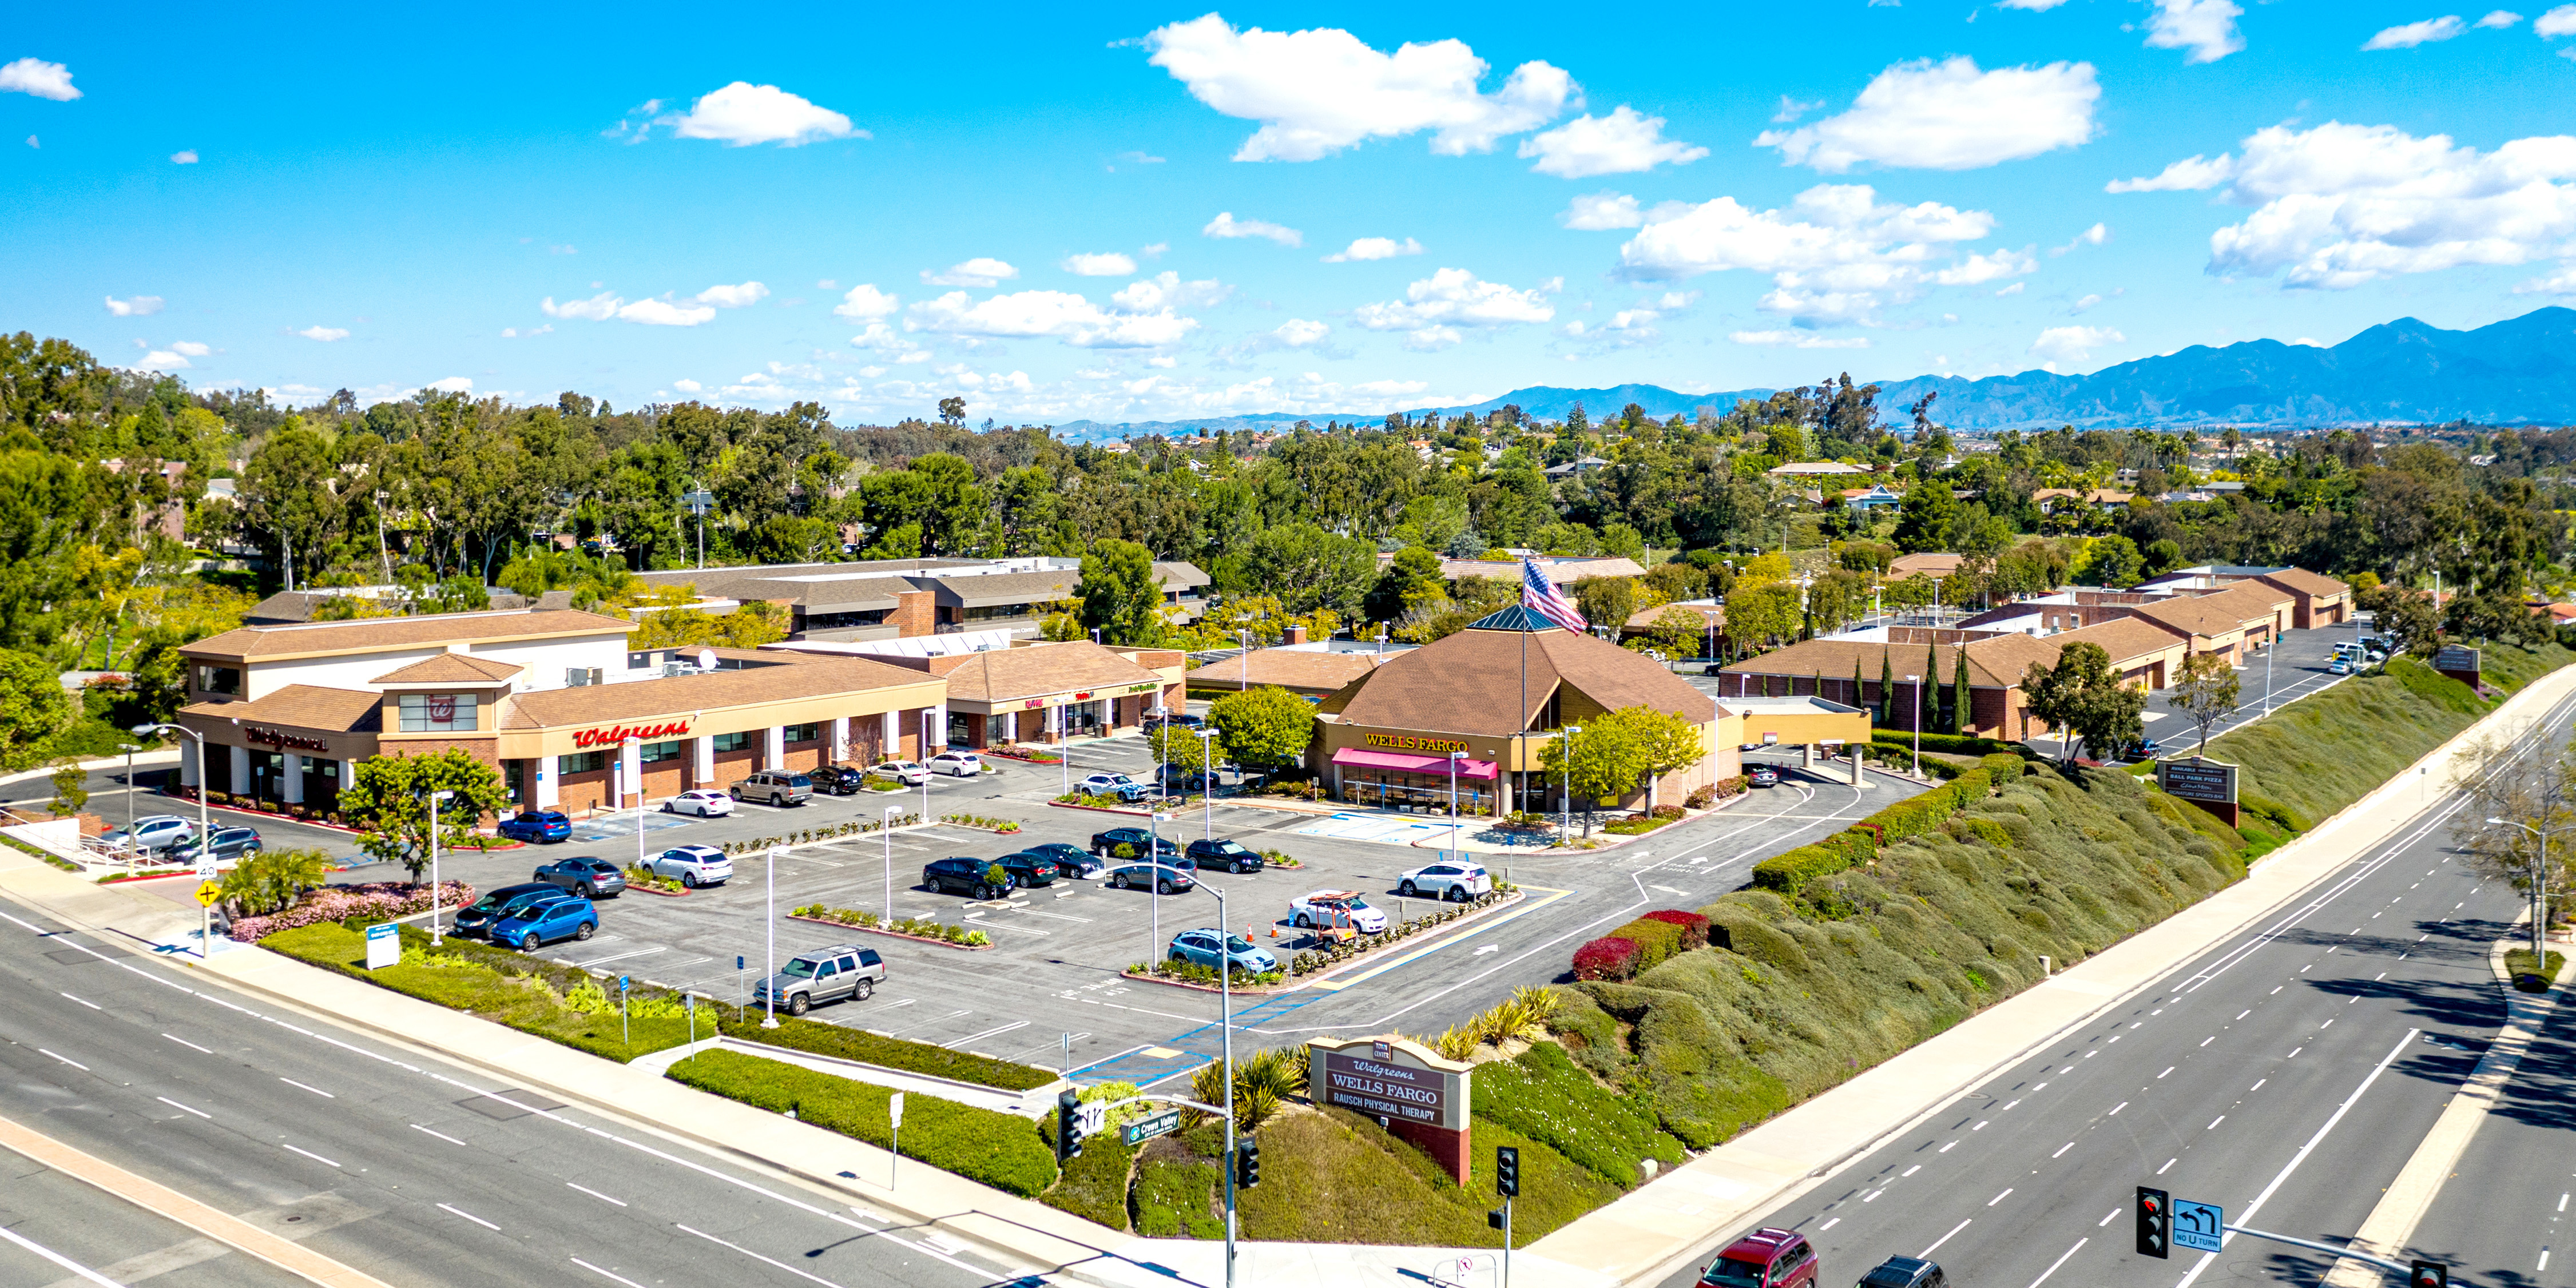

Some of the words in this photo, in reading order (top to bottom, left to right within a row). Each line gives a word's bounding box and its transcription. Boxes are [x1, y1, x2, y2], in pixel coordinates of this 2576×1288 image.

[573, 720, 690, 746] Walgreens
[1365, 733, 1415, 749] WELLS
[1418, 738, 1468, 753] FARGO
[200, 866, 215, 875] 40
[1374, 1051, 1389, 1059] CENTER
[1375, 1043, 1387, 1051] TOWN
[1353, 1060, 1415, 1080] Walgreens
[1332, 1074, 1383, 1094] WELLS
[1386, 1084, 1437, 1104] FARGO
[1334, 1093, 1363, 1107] RAUSCH
[1364, 1098, 1399, 1114] PHYSICAL
[1401, 1106, 1435, 1121] THERAPY
[1141, 1122, 1159, 1134] Crown
[1160, 1115, 1178, 1127] Valley
[2189, 1235, 2197, 1245] U
[2198, 1238, 2218, 1247] TURN
